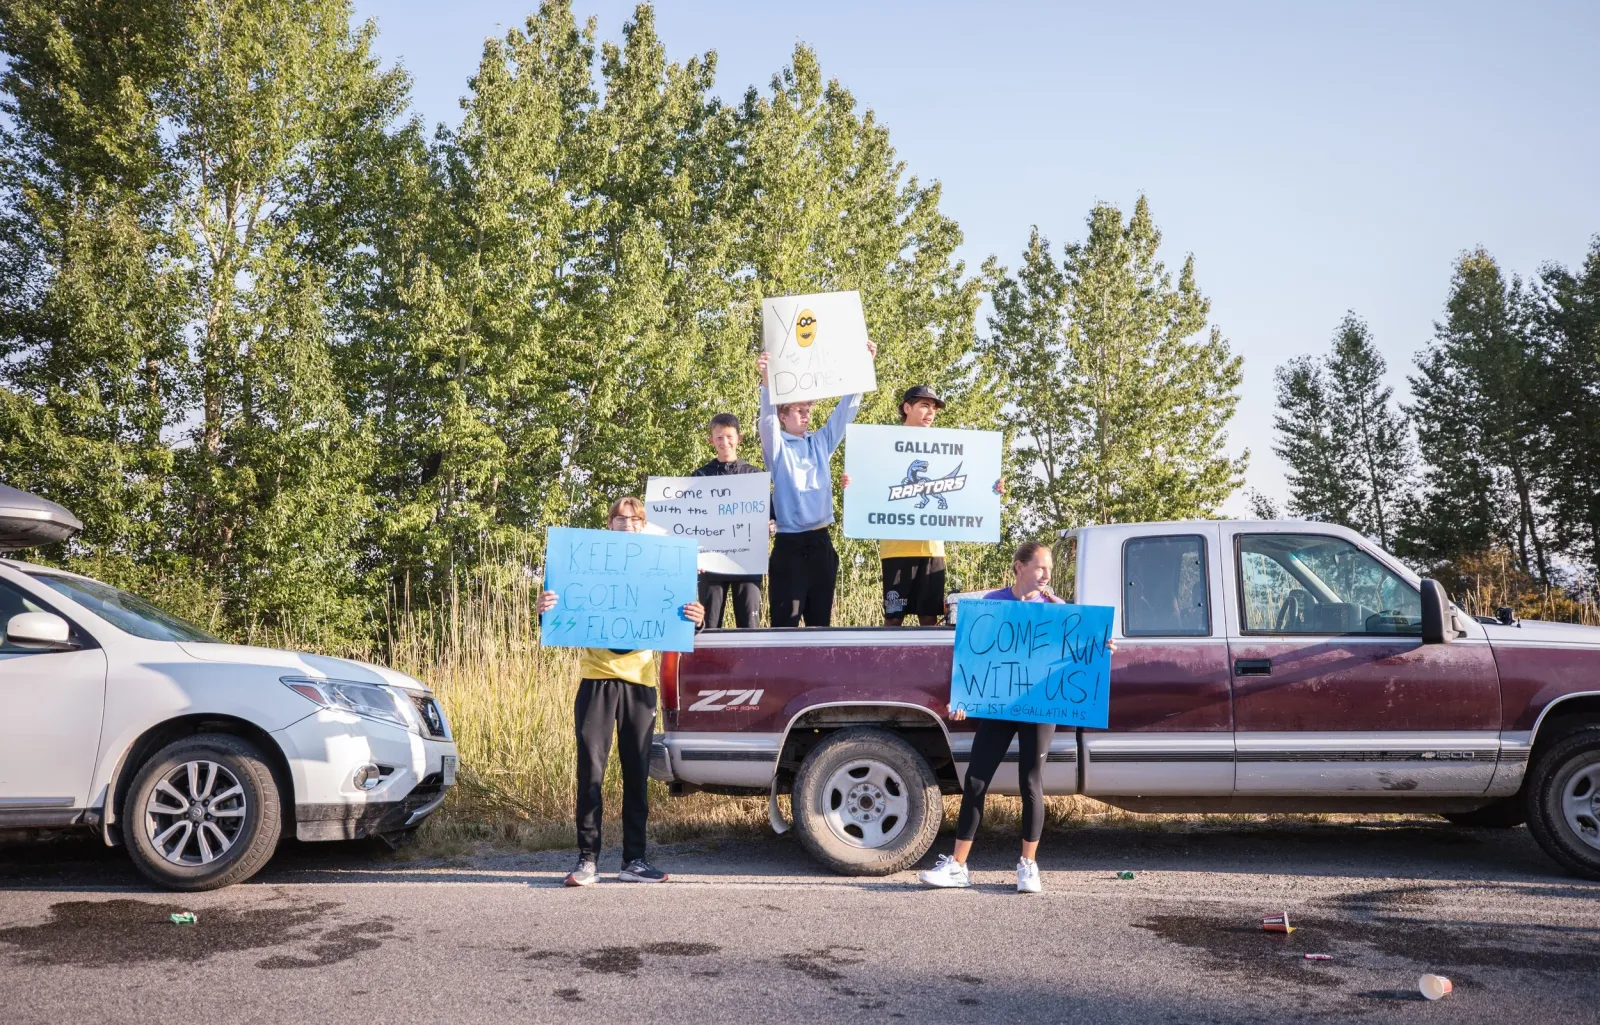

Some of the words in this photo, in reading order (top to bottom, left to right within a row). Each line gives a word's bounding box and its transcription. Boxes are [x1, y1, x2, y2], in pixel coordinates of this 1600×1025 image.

[895, 441, 964, 455] GALLATIN
[663, 487, 703, 499] Come
[710, 488, 731, 498] run
[889, 476, 966, 500] RAPTORS
[688, 506, 708, 515] the
[718, 501, 766, 516] RAPTORS
[673, 523, 725, 537] October
[868, 512, 915, 526] CROSS
[920, 514, 983, 528] COUNTRY
[569, 542, 642, 571] KEEP
[649, 544, 688, 572] IT
[564, 583, 639, 610] GOIN
[586, 616, 666, 640] FLOWIN
[969, 614, 1052, 658] COME
[959, 661, 1033, 698] WITH
[688, 689, 764, 711] Z71
[987, 703, 1006, 715] 1ST
[1010, 705, 1068, 718] @GALLATIN
[1072, 711, 1087, 720] HS
